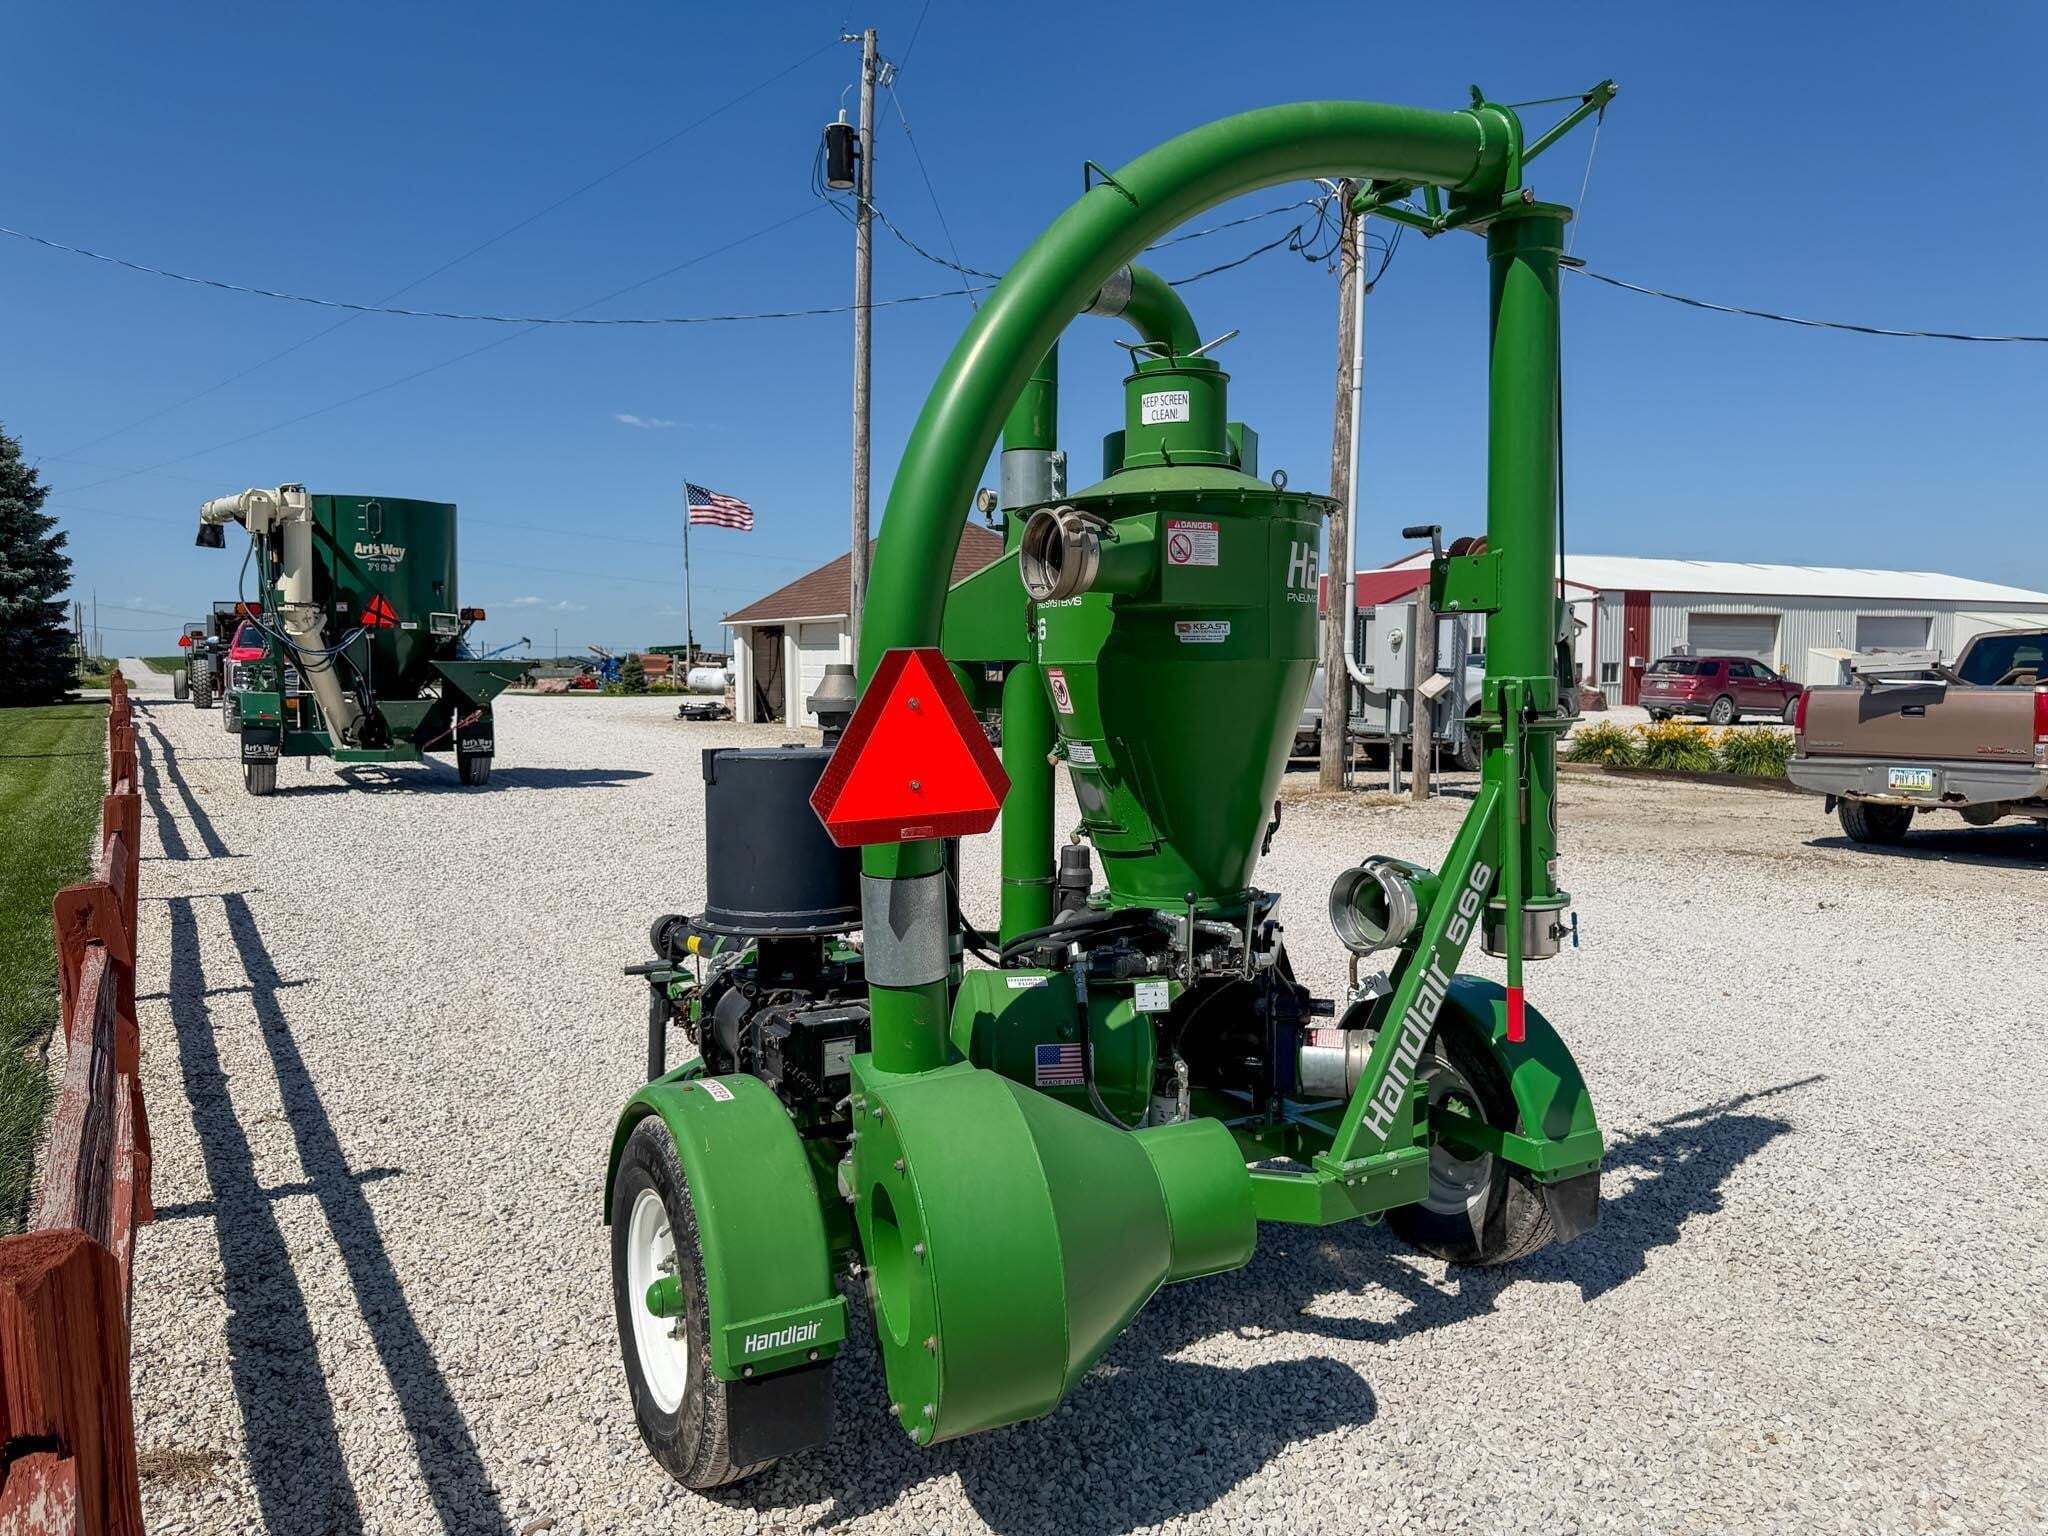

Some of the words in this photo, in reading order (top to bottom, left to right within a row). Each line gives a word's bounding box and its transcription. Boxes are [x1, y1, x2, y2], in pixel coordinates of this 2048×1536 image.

[1143, 396, 1159, 408] KEEP
[1160, 394, 1188, 406] SCREEN
[1151, 408, 1178, 421] CLEAN!
[1180, 521, 1213, 530] DANGER
[354, 542, 380, 554] Art's
[381, 543, 406, 561] Way
[1445, 861, 1492, 946] 566
[1362, 953, 1450, 1142] Handlair
[744, 1319, 822, 1354] Handlair
